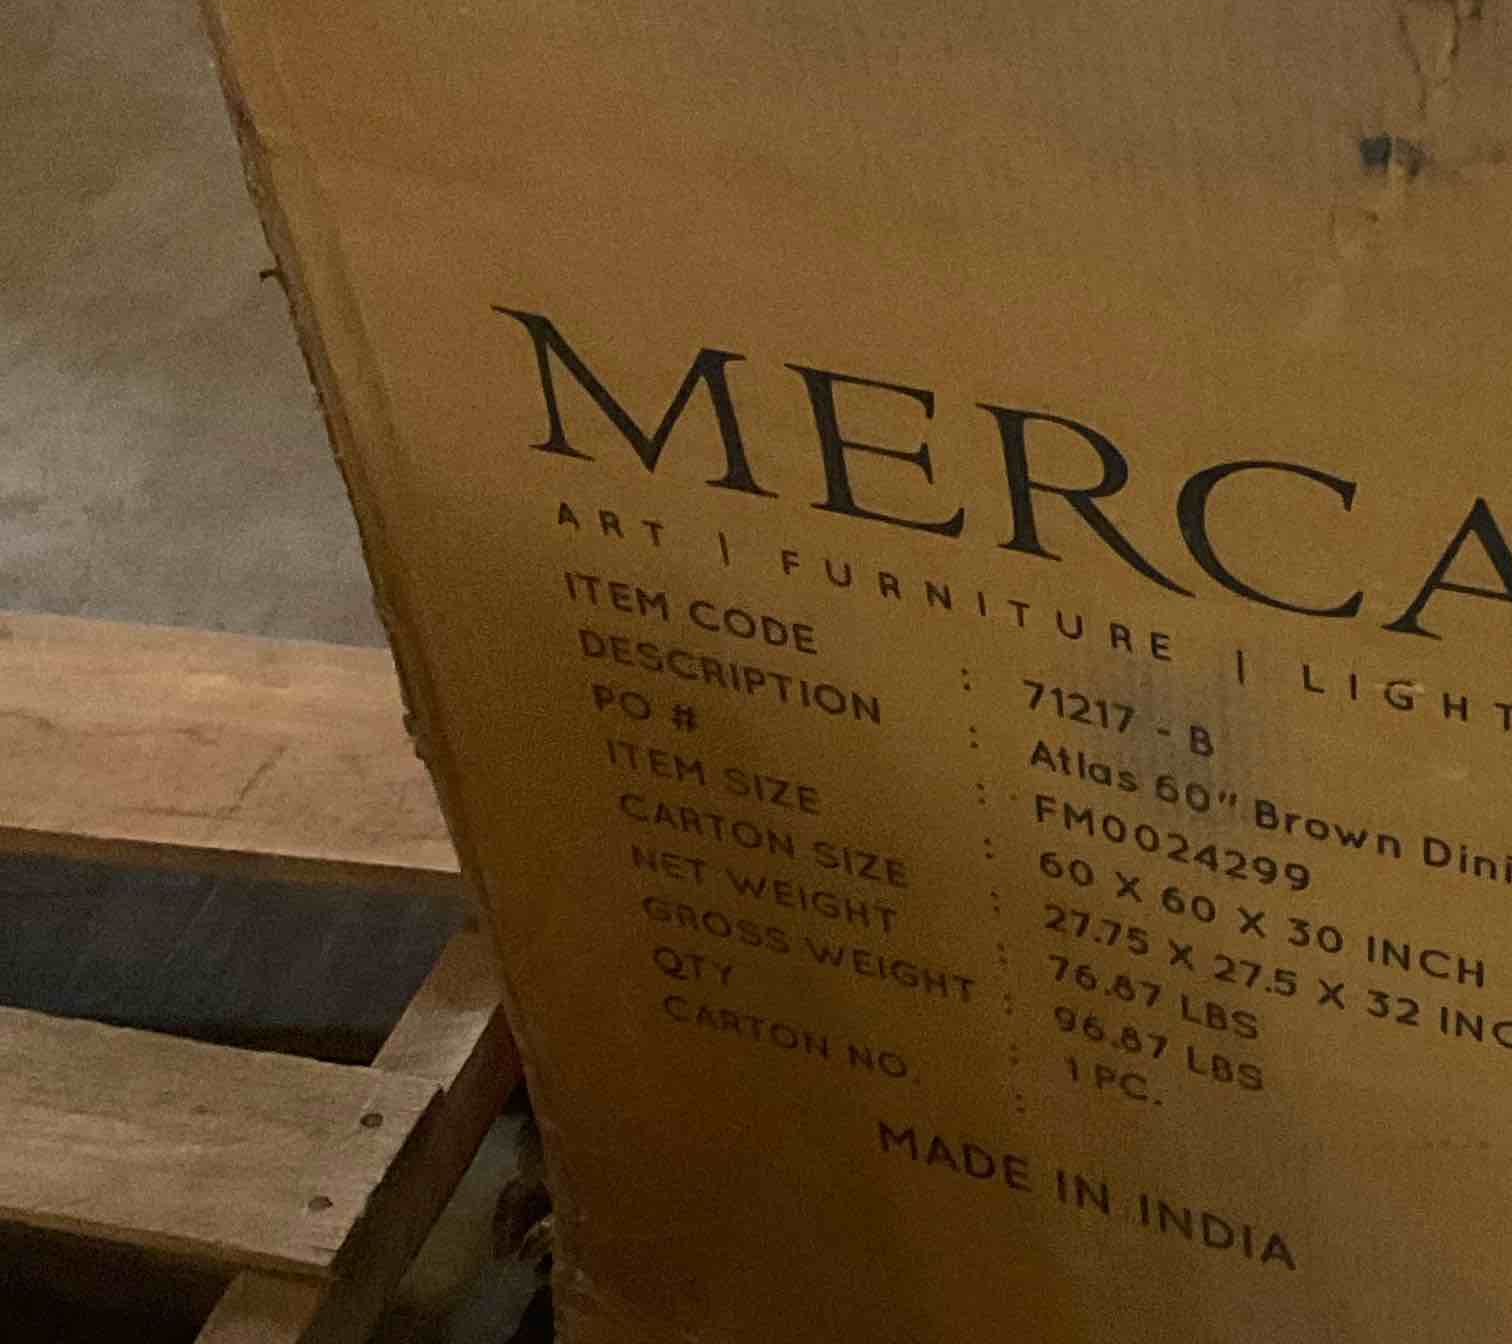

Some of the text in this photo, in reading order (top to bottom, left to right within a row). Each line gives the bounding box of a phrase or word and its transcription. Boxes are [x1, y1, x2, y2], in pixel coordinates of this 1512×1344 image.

[557, 502, 664, 547] ART
[781, 549, 1172, 662] FURNITURE
[563, 571, 669, 622] ITEM
[688, 600, 818, 655] CODE
[1021, 679, 1135, 734] 71217
[1189, 725, 1214, 758] B
[577, 628, 881, 724] DESCRIPTION
[1029, 739, 1138, 793] Atlas
[1255, 800, 1402, 858] Brown
[590, 683, 653, 723] PO
[670, 703, 697, 731] #
[1033, 794, 1313, 893] FM0024299
[605, 739, 706, 786] ITEM
[721, 767, 822, 816] SIZE
[1039, 850, 1095, 887] 60
[1114, 870, 1143, 904] X
[1160, 886, 1217, 924] 60
[1237, 904, 1267, 939] X
[1286, 917, 1344, 954] 30
[1366, 934, 1487, 988] INCH
[619, 791, 795, 857] CARTON
[811, 841, 910, 889] SIZE
[1043, 903, 1150, 955] 27.75
[1166, 936, 1195, 971] X
[1213, 952, 1298, 999] 27.5
[1316, 979, 1347, 1012] X
[1366, 989, 1420, 1028] 32
[631, 844, 707, 885] NET
[724, 866, 898, 935] WEIGHT
[1047, 955, 1162, 1008] 76.87
[1180, 994, 1259, 1040] LBS
[641, 894, 792, 957] GROSS
[804, 936, 977, 1004] WEIGHT
[1053, 1005, 1170, 1060] 96.87
[1185, 1046, 1265, 1093] LBS
[651, 946, 734, 988] QTY
[1062, 1055, 1080, 1082] 1
[1093, 1066, 1164, 1107] PC.
[663, 994, 830, 1061] CARTON
[847, 1044, 921, 1085] NO.
[877, 1121, 1298, 1271] MADE IN INDIA
